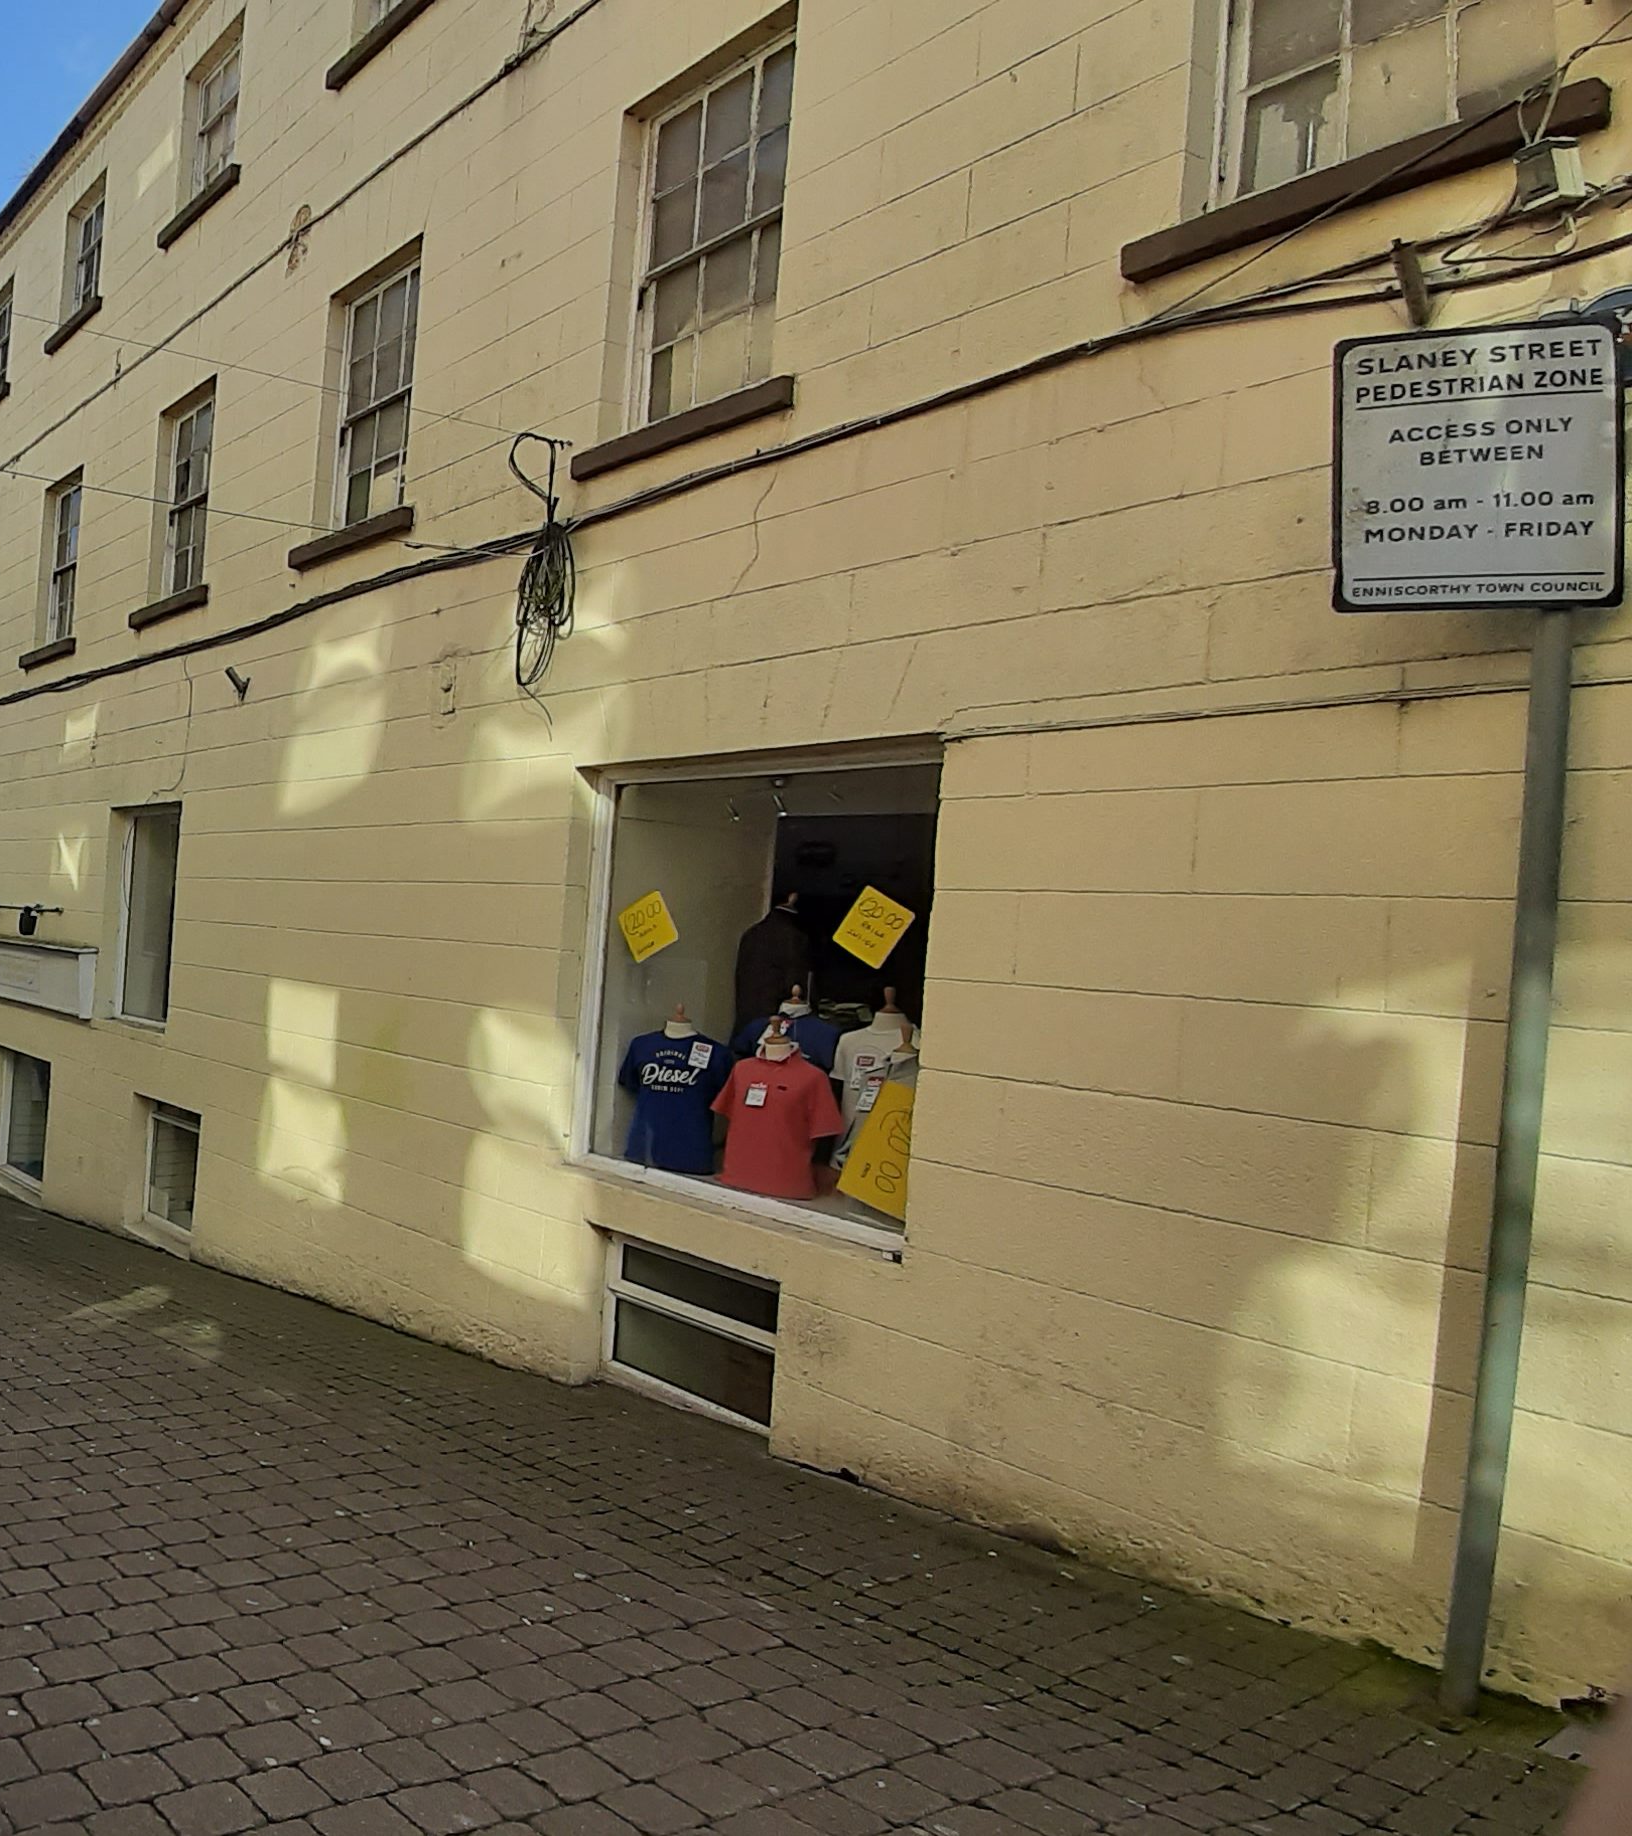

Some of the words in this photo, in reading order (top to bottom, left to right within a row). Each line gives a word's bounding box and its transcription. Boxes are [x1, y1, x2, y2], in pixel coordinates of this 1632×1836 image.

[1356, 348, 1478, 376] SLANEY
[1489, 339, 1602, 364] STREET
[1356, 373, 1524, 404] PEDESTRIAN
[1534, 368, 1604, 389] ZONE
[1388, 421, 1496, 444] ACCESS
[1505, 417, 1574, 435] ONLY
[1419, 444, 1544, 466] BETWEEN
[1365, 496, 1424, 516] 8.00
[1433, 496, 1468, 511] am
[1493, 490, 1554, 509] 11.00
[1562, 491, 1595, 506] am
[1364, 524, 1479, 544] MONDAY
[1504, 520, 1595, 538] FRIDAY
[1352, 583, 1471, 598] ENNISCORTHY
[1477, 582, 1524, 595] TOWN
[1530, 581, 1605, 593] COUNCIL
[642, 1063, 700, 1085] Diesel
